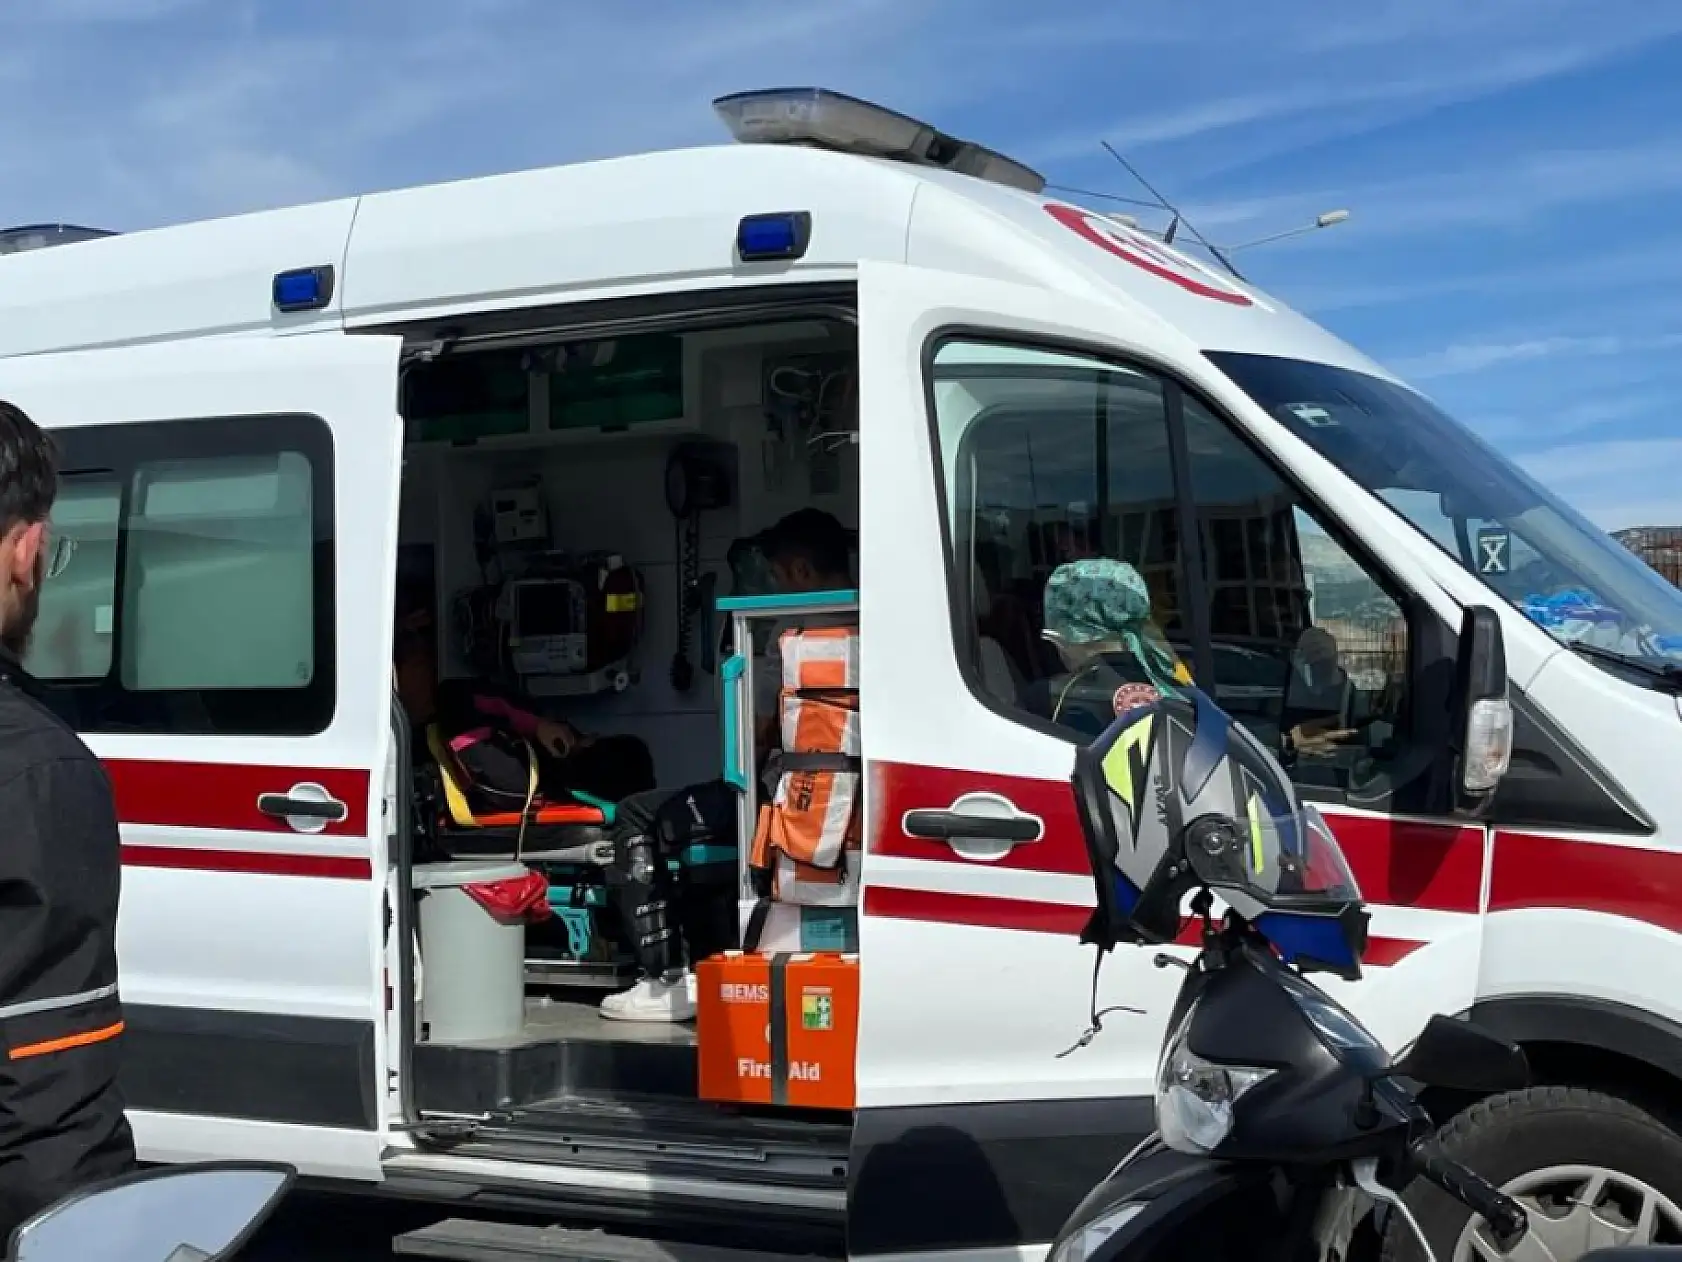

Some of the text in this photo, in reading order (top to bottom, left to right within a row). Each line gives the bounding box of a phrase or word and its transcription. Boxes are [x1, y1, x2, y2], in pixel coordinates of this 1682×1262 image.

[735, 984, 769, 1001] EMS
[738, 1058, 820, 1080] Firs Aid
